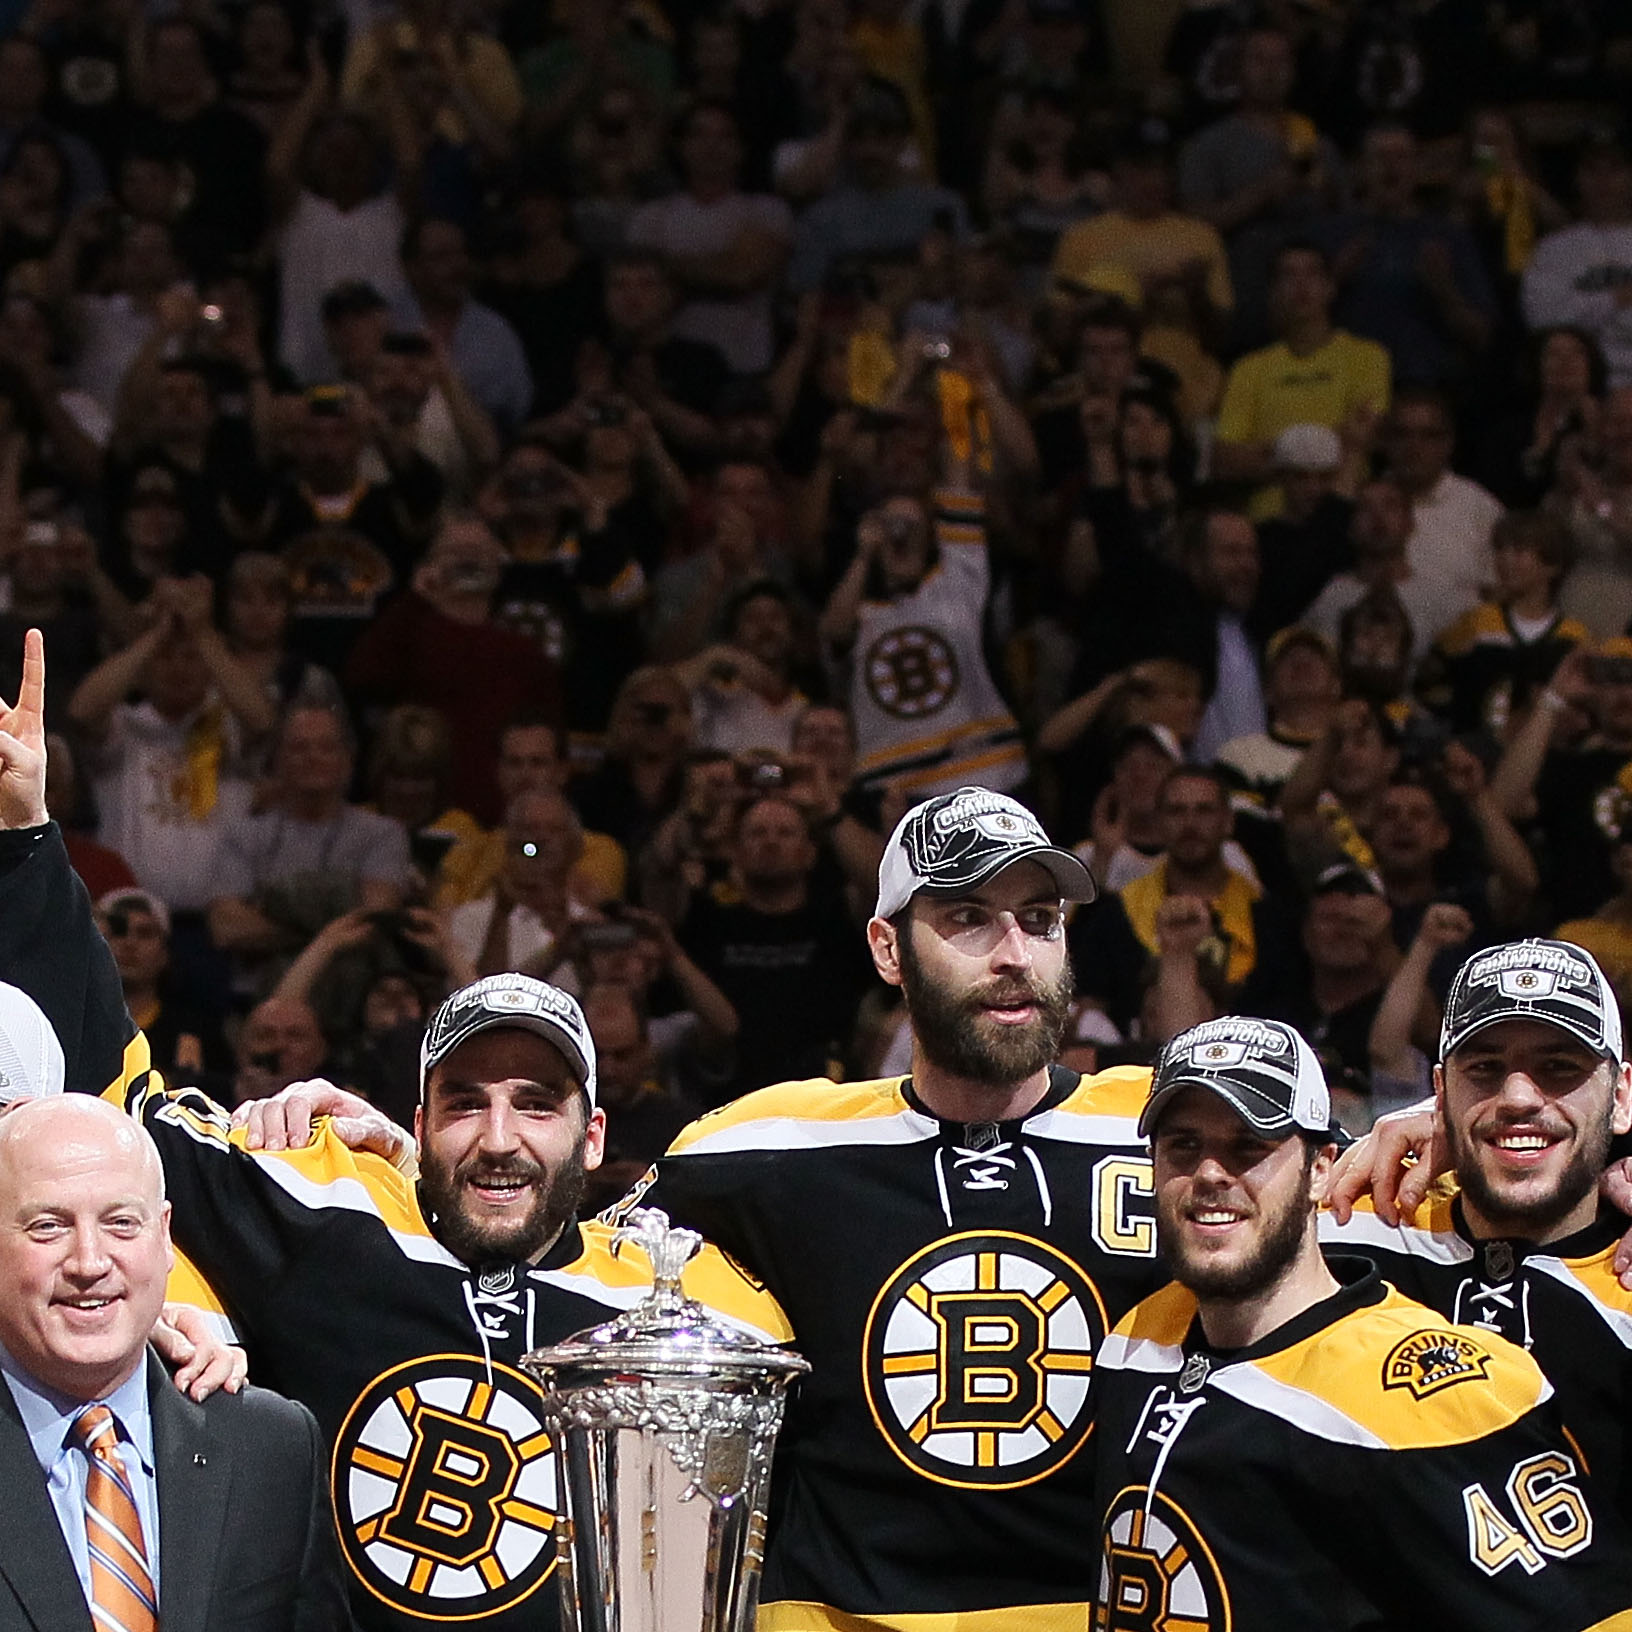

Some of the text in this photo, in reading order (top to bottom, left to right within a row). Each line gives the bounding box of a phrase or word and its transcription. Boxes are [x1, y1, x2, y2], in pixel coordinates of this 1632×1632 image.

[1091, 1155, 1157, 1258] C
[1392, 1333, 1479, 1378] BRUINS
[1463, 1450, 1593, 1576] 46
